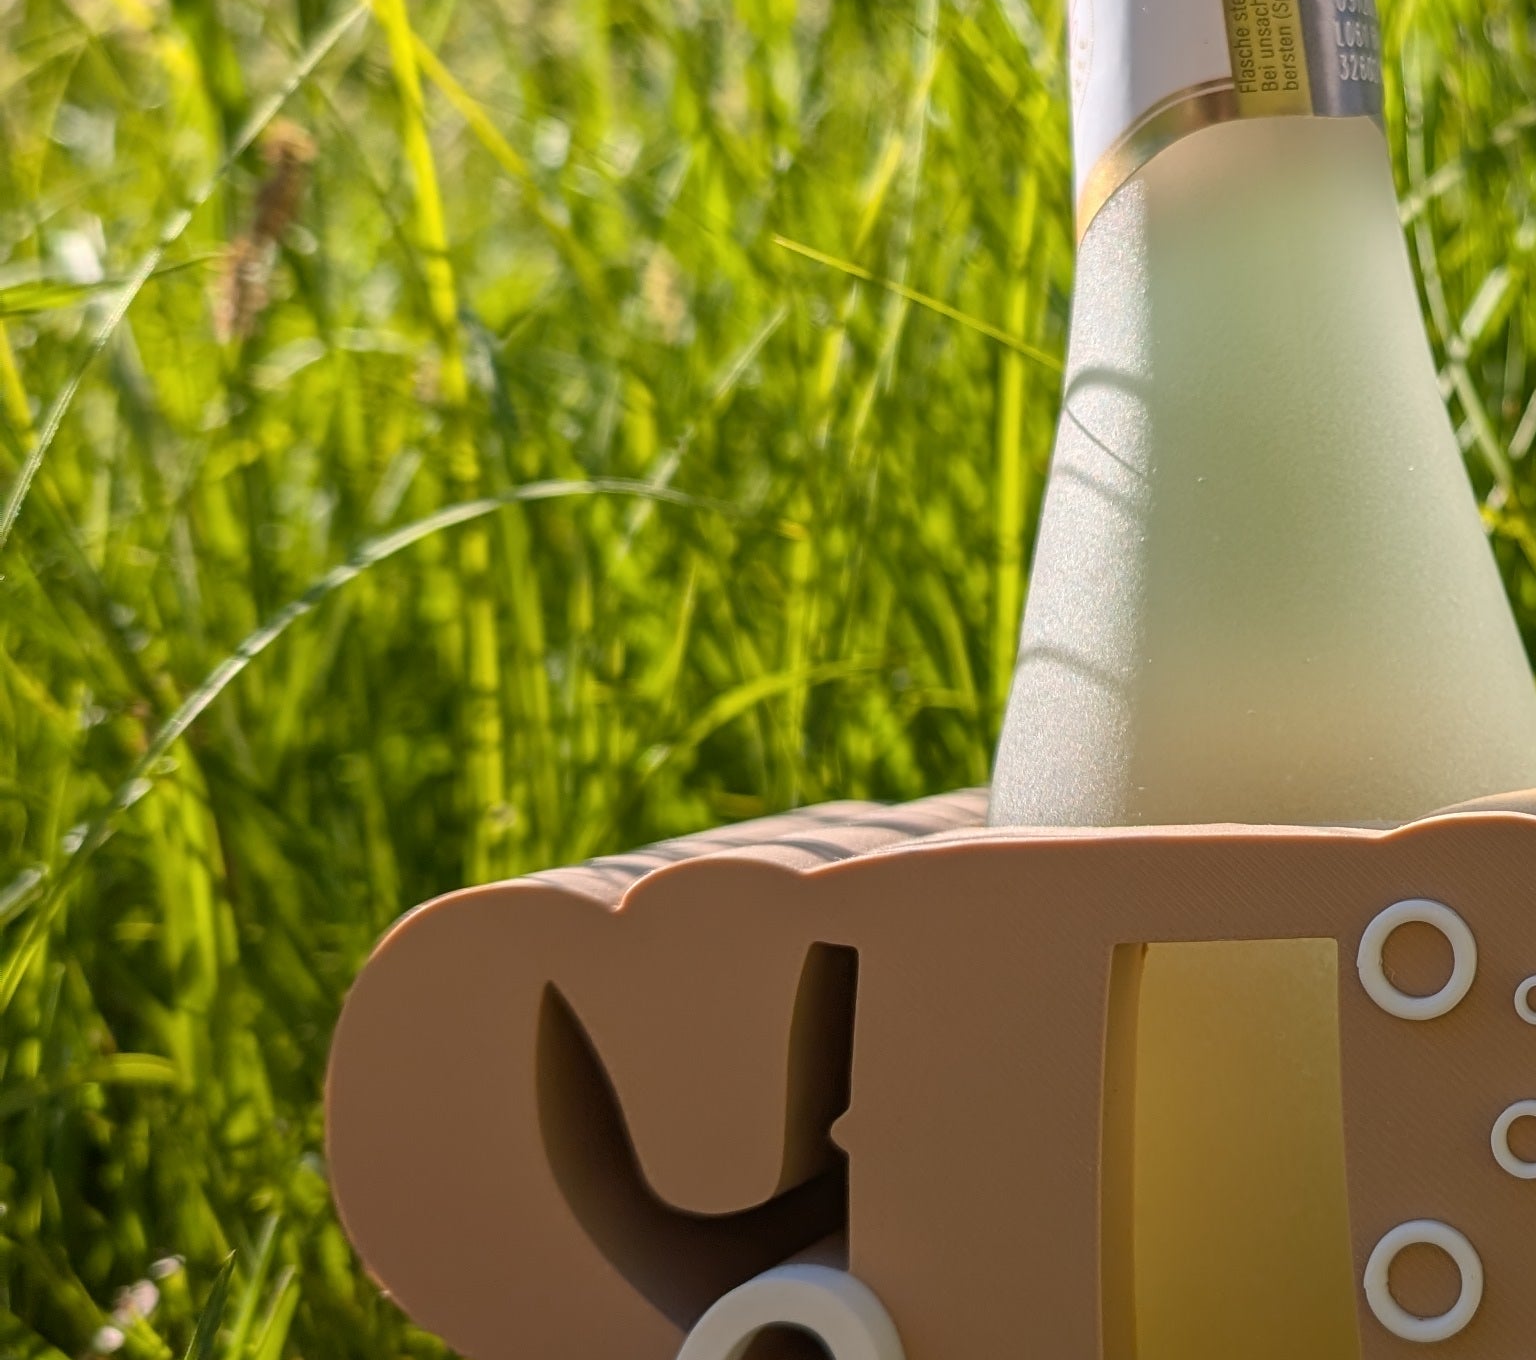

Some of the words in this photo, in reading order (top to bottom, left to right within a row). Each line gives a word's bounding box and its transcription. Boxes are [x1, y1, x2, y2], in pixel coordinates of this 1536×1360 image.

[1234, 27, 1257, 93] Flasche
[1258, 65, 1278, 92] Bei
[1278, 26, 1299, 91] bersten
